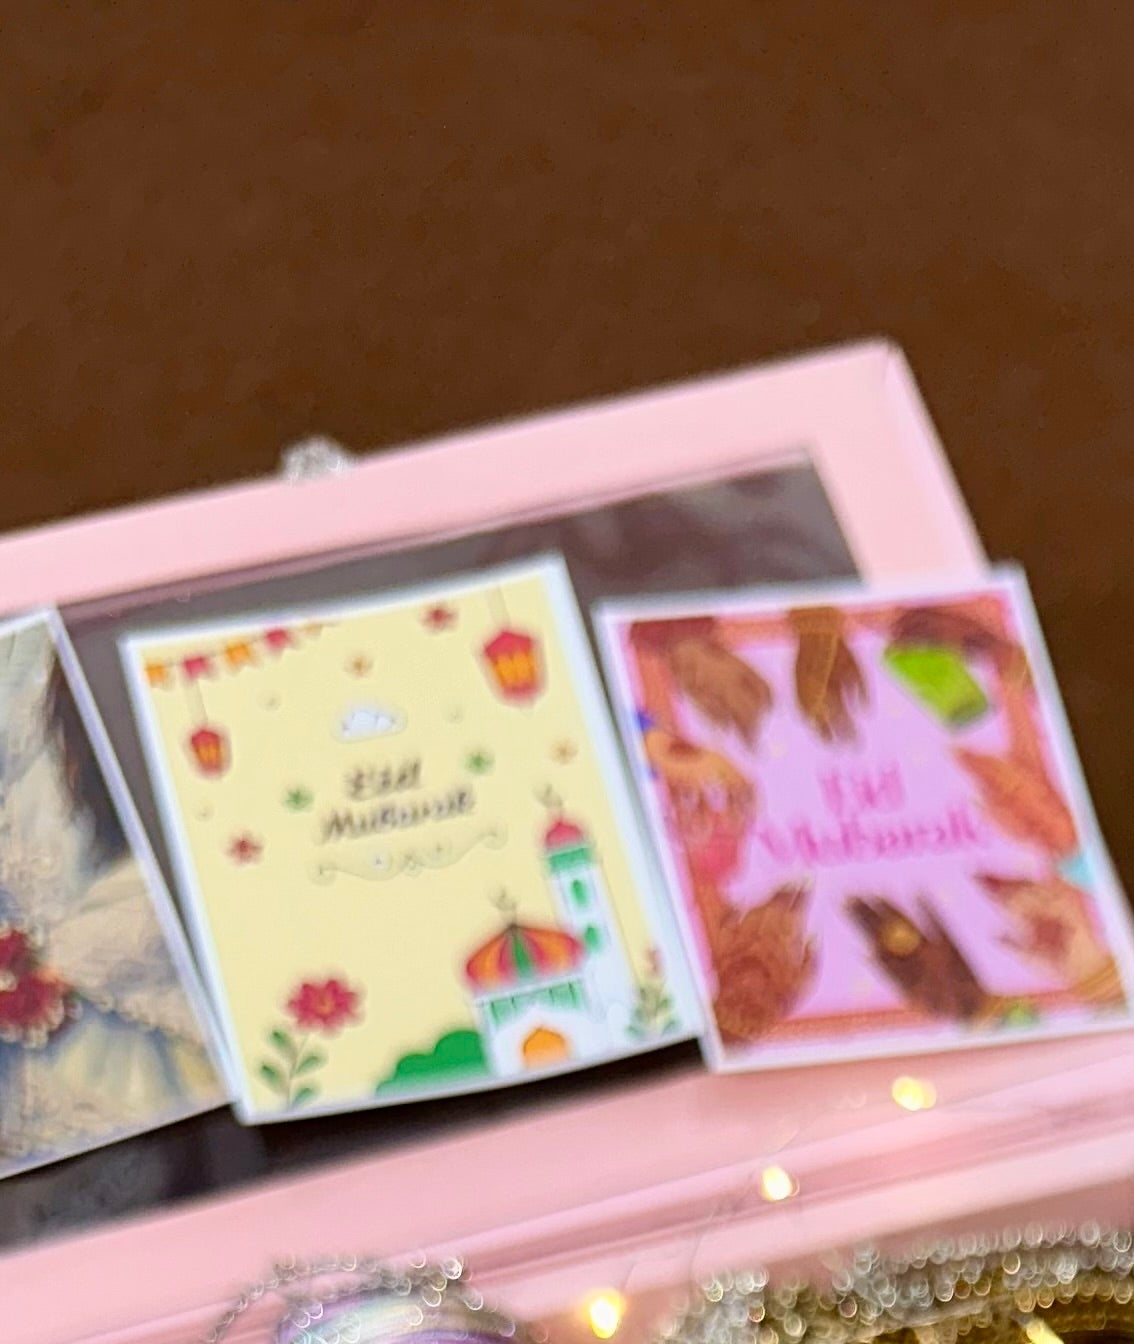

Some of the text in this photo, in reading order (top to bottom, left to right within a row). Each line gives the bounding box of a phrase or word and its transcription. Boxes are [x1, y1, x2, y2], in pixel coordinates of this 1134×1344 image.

[345, 757, 421, 801] Eid
[818, 765, 904, 815] Eid
[317, 788, 475, 843] Mubarak
[757, 804, 980, 864] Mubarak
